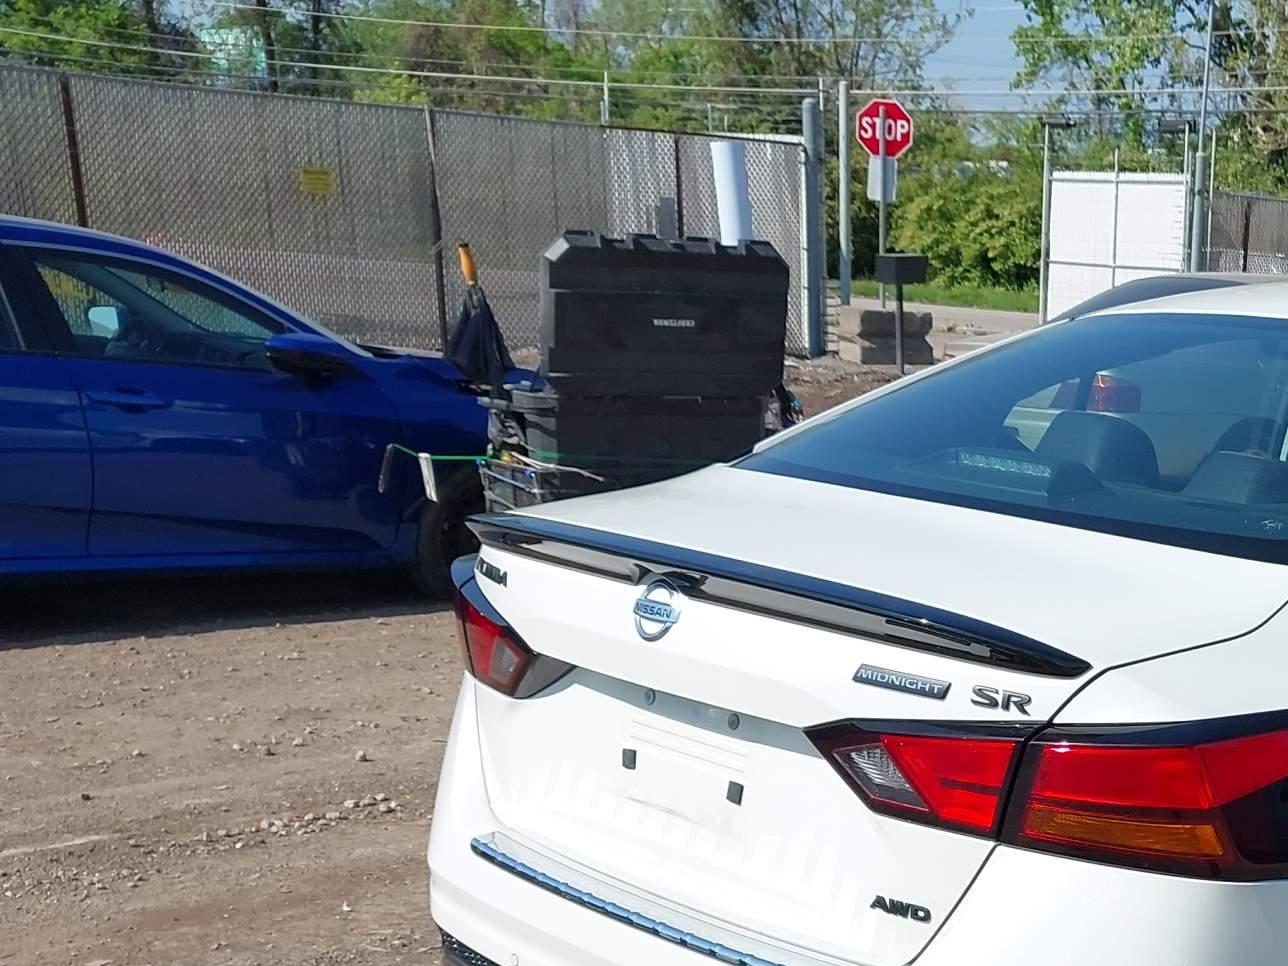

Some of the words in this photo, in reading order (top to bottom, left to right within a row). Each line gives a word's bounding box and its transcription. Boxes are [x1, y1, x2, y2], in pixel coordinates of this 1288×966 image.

[860, 116, 909, 141] STOP
[636, 601, 672, 619] NISSAN
[857, 668, 944, 695] MIDNIGHT
[970, 684, 1033, 717] SR
[870, 895, 932, 924] AWD
